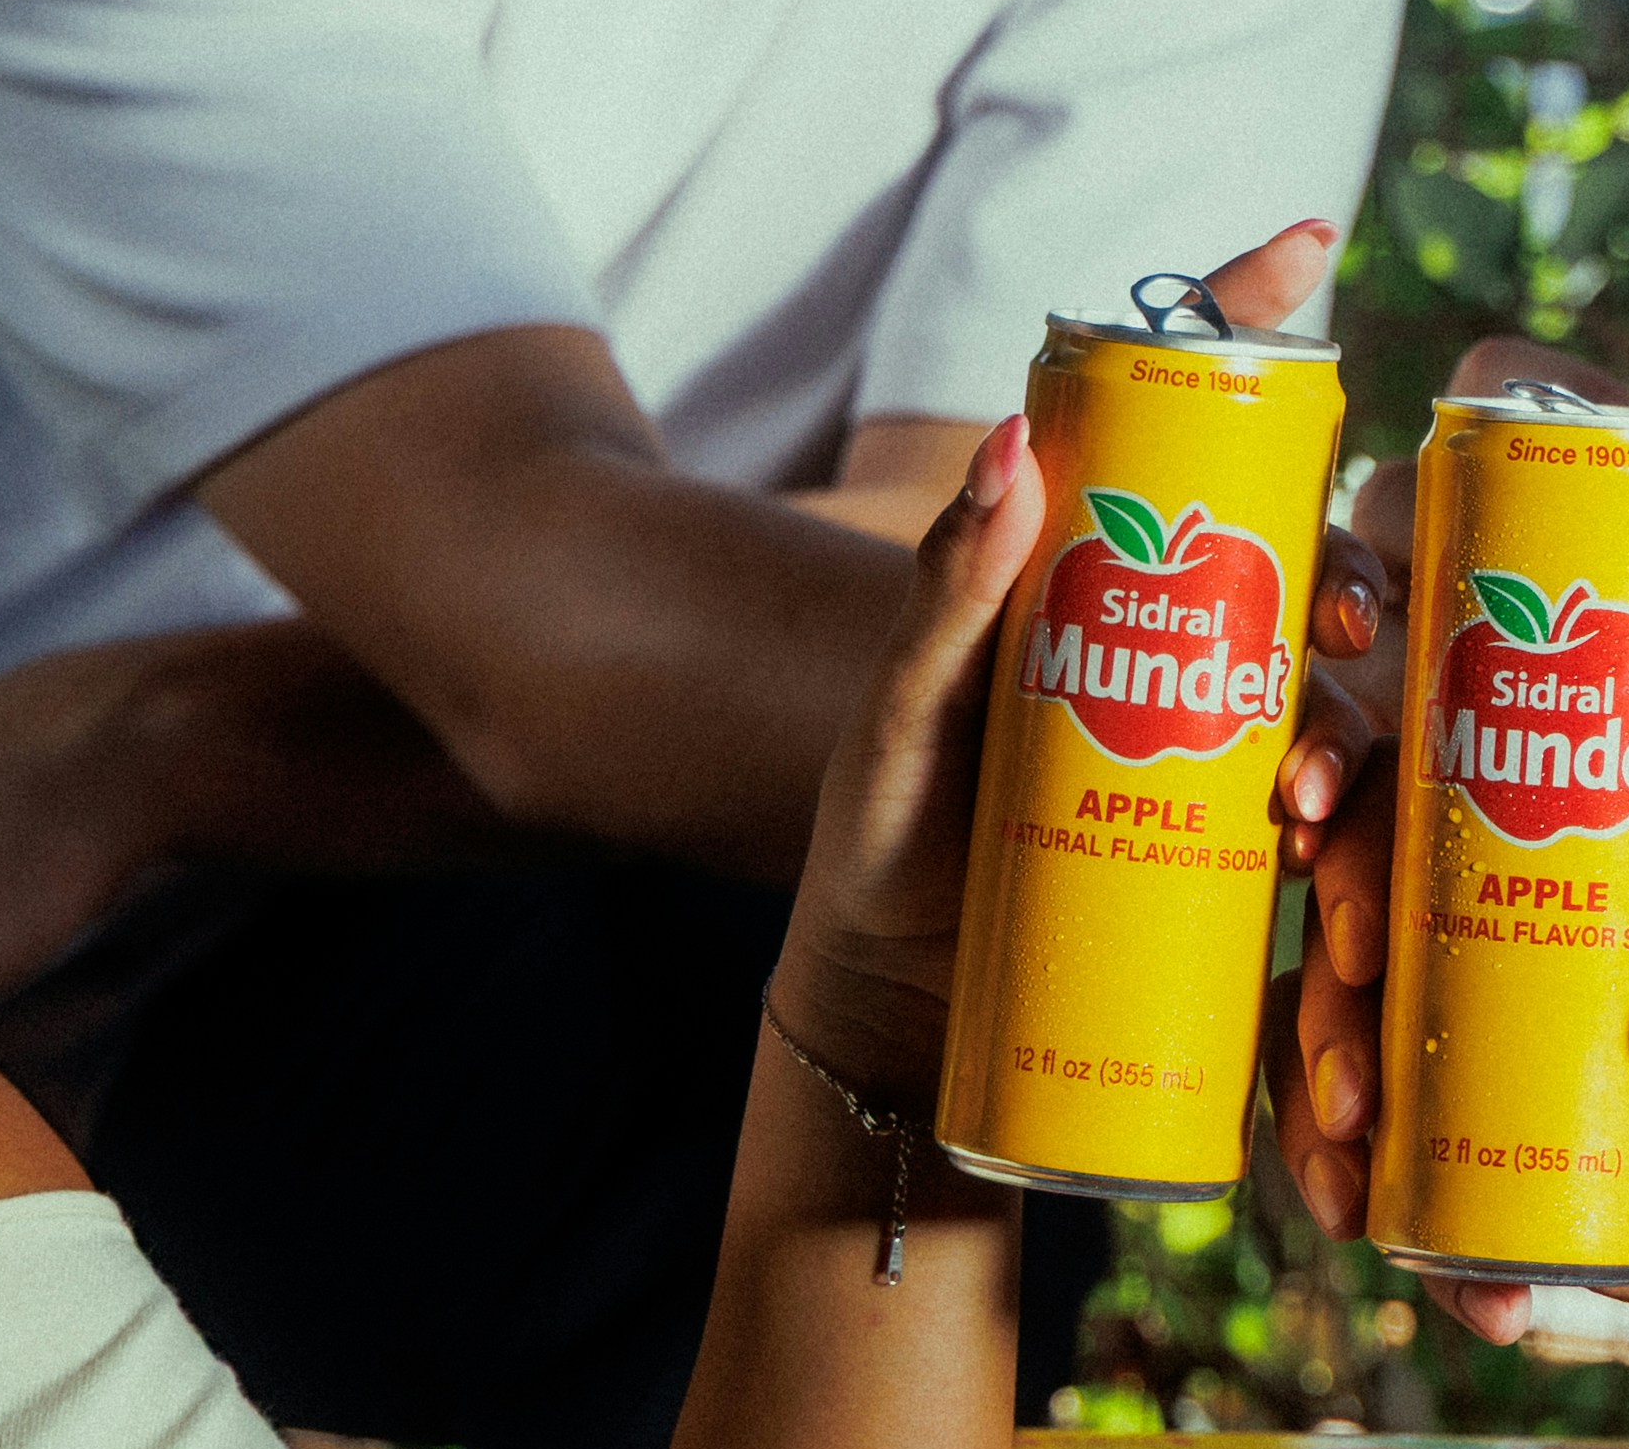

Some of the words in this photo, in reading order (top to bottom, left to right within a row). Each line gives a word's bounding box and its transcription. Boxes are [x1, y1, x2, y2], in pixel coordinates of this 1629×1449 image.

[1130, 359, 1200, 389] Since
[1209, 370, 1261, 396] 1902
[1506, 437, 1577, 465] Since
[1100, 588, 1226, 638] Sidral
[1022, 618, 1287, 716] Mundet
[1490, 669, 1615, 715] Sidral
[1075, 788, 1207, 834] APPLE
[1001, 819, 1103, 858] NATURAL
[1110, 837, 1211, 869] FLAVOR
[1217, 848, 1268, 872] SODA
[1476, 873, 1610, 913] APPLE
[1407, 909, 1507, 943] NATURAL
[1513, 920, 1616, 949] FLAVOR
[1014, 1046, 1035, 1072] 12
[1042, 1048, 1056, 1076] fl
[1063, 1059, 1091, 1081] oz
[1099, 1057, 1155, 1088] (355
[1161, 1066, 1204, 1095] mL)
[1430, 1137, 1451, 1163] 12
[1457, 1137, 1471, 1164] fl
[1477, 1147, 1507, 1168] oz
[1514, 1143, 1570, 1174] (355
[1577, 1148, 1622, 1178] mL)
